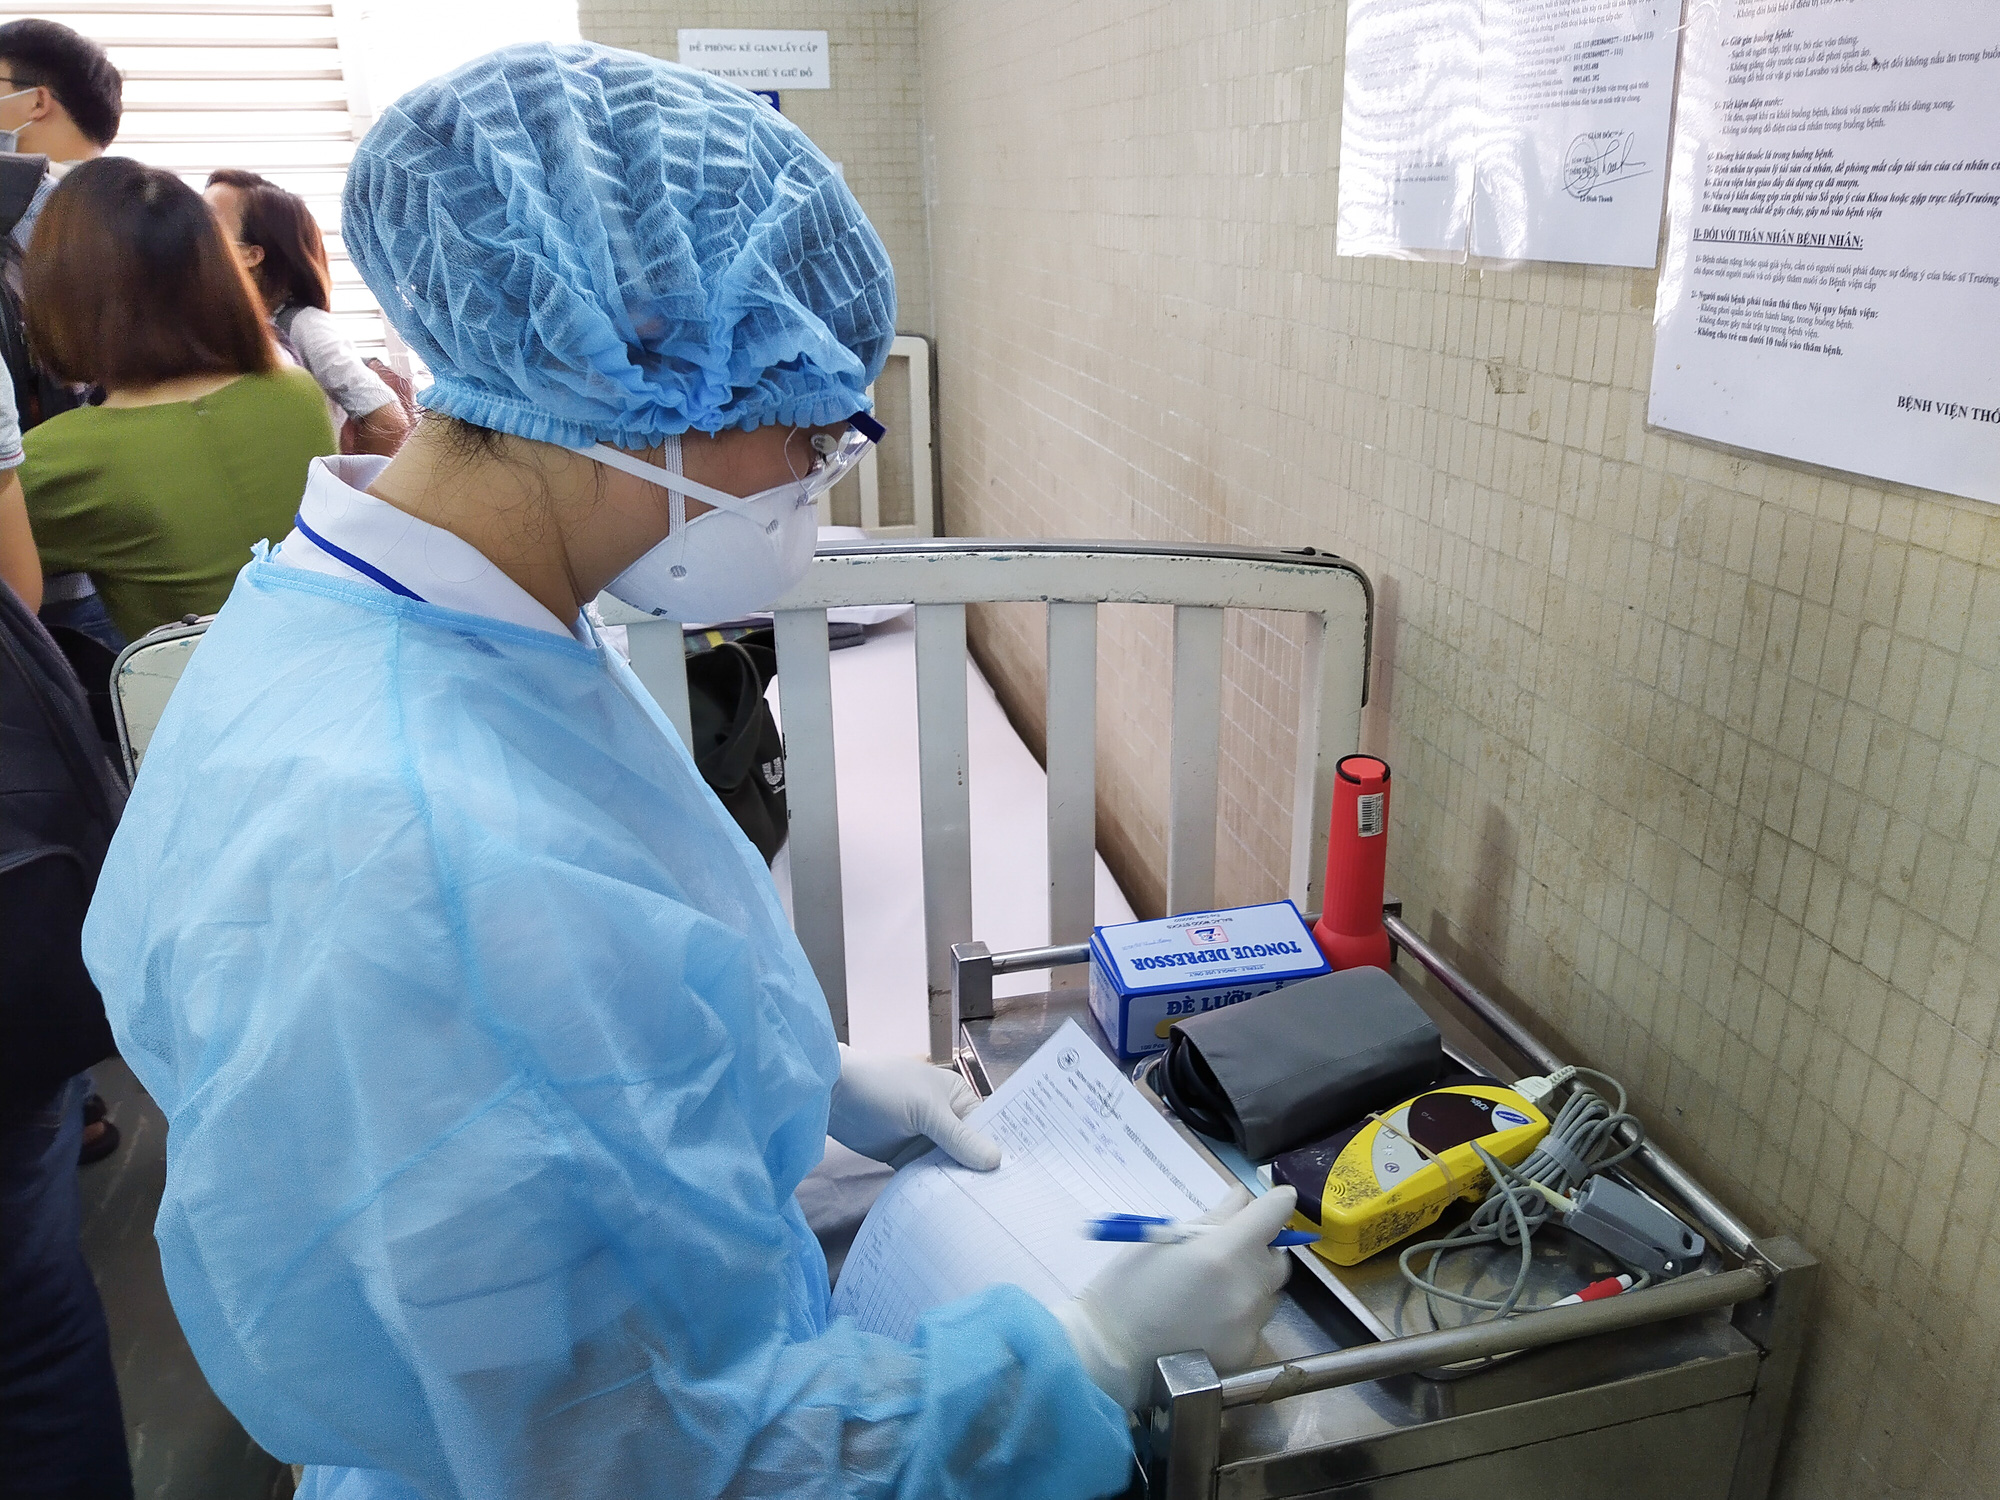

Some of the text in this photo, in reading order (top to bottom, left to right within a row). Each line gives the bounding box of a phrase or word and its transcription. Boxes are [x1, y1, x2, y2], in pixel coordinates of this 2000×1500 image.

[1897, 395, 1932, 412] BỆNH
[1130, 940, 1302, 972] TONGUE DEPRESSOR
[1167, 995, 1196, 1015] ĐÈ
